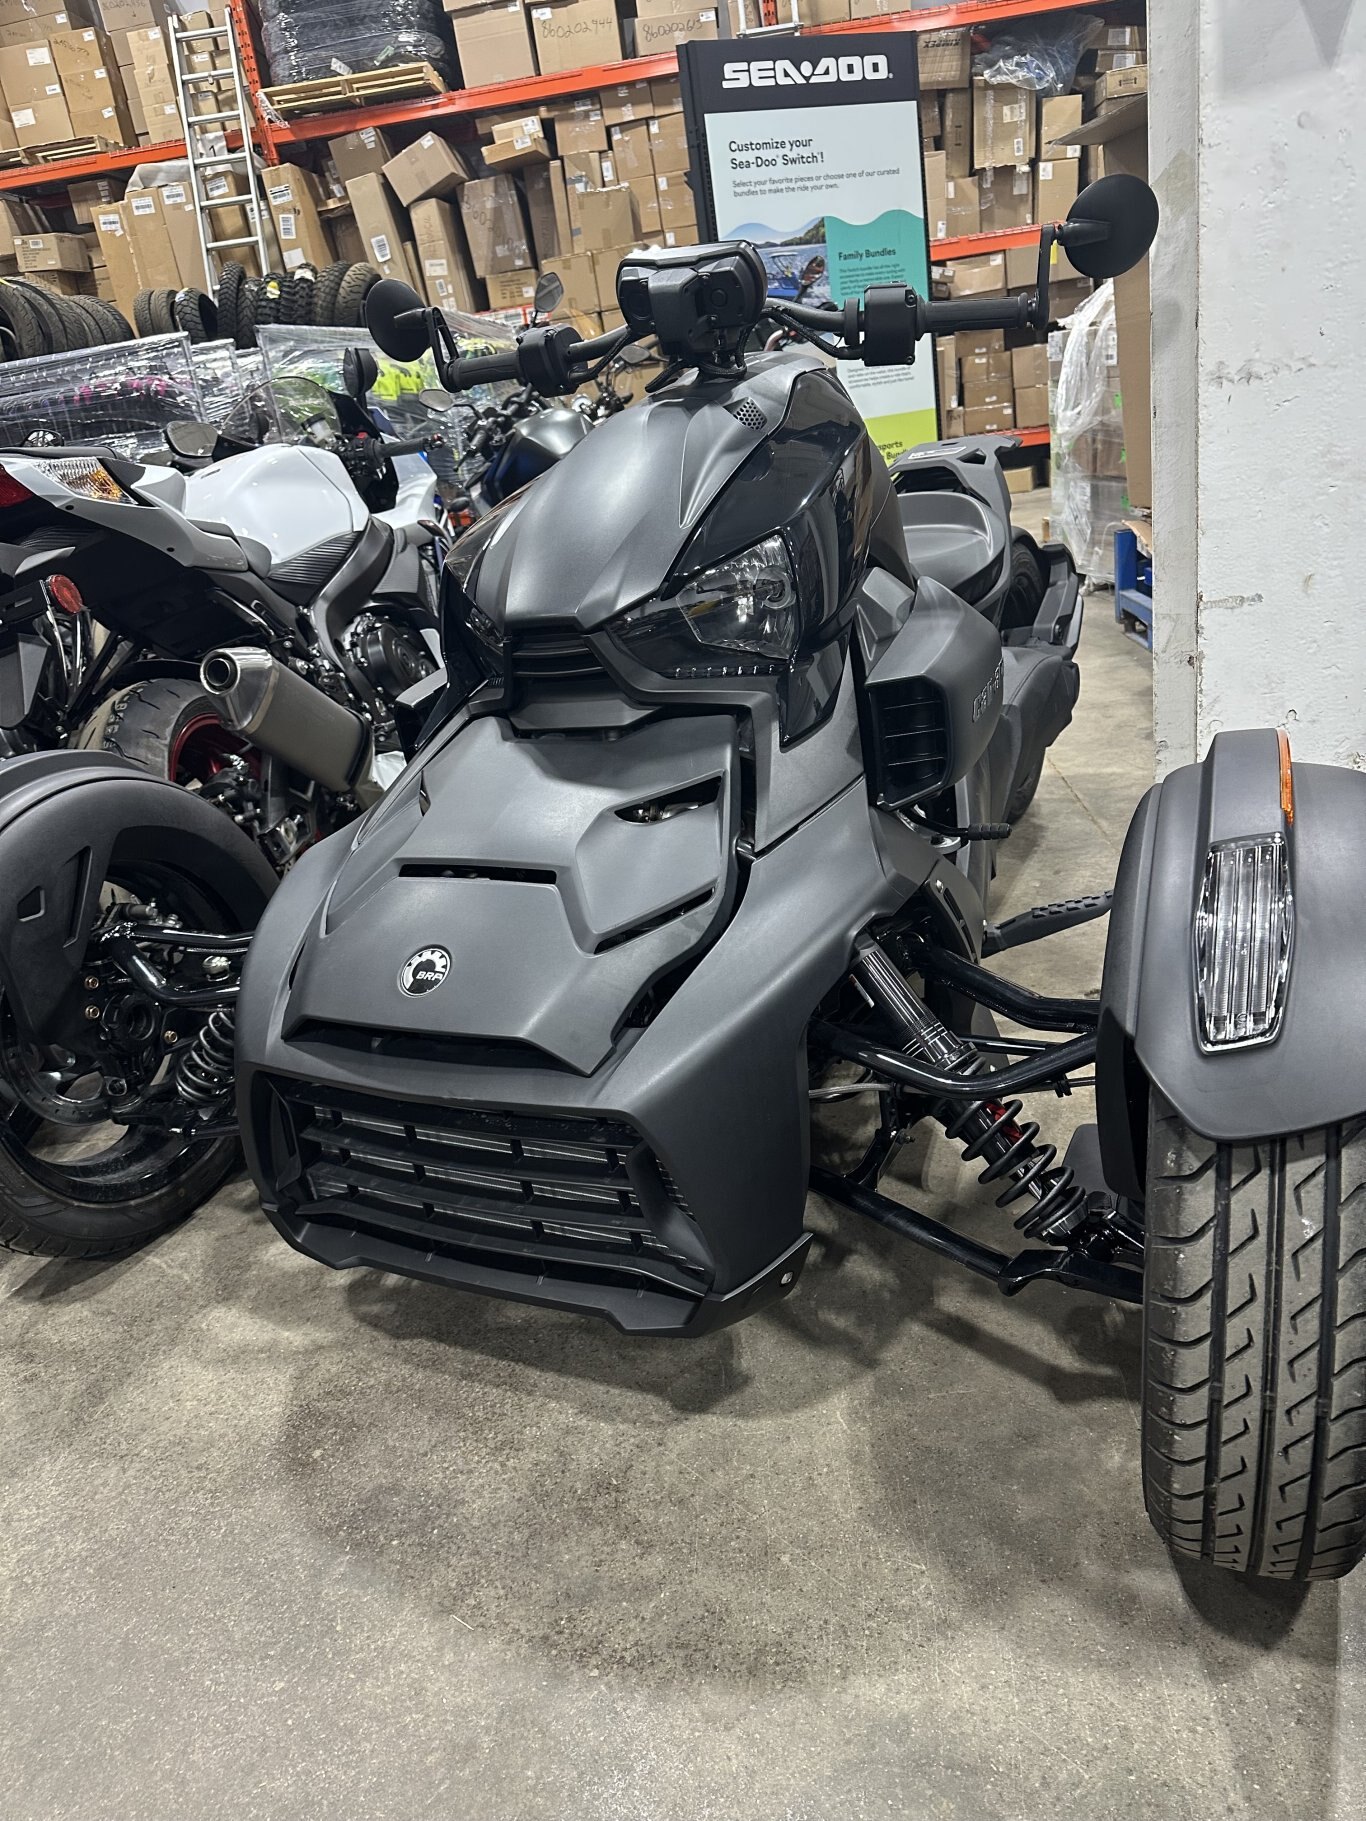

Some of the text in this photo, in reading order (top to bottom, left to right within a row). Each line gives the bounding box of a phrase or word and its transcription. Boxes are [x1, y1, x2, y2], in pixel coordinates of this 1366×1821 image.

[728, 138, 813, 152] Customize your
[732, 180, 752, 188] Select
[753, 179, 768, 187] your
[769, 177, 793, 186] favorite
[794, 175, 814, 184] pieces
[823, 172, 844, 180] choose
[876, 167, 900, 176] curated
[733, 189, 759, 197] bundles
[759, 188, 767, 196] to
[768, 186, 784, 194] make
[785, 185, 796, 193] the
[796, 184, 809, 192] ride
[810, 184, 824, 193] your
[838, 247, 896, 261] Family Bundles
[416, 971, 443, 981] BRP
